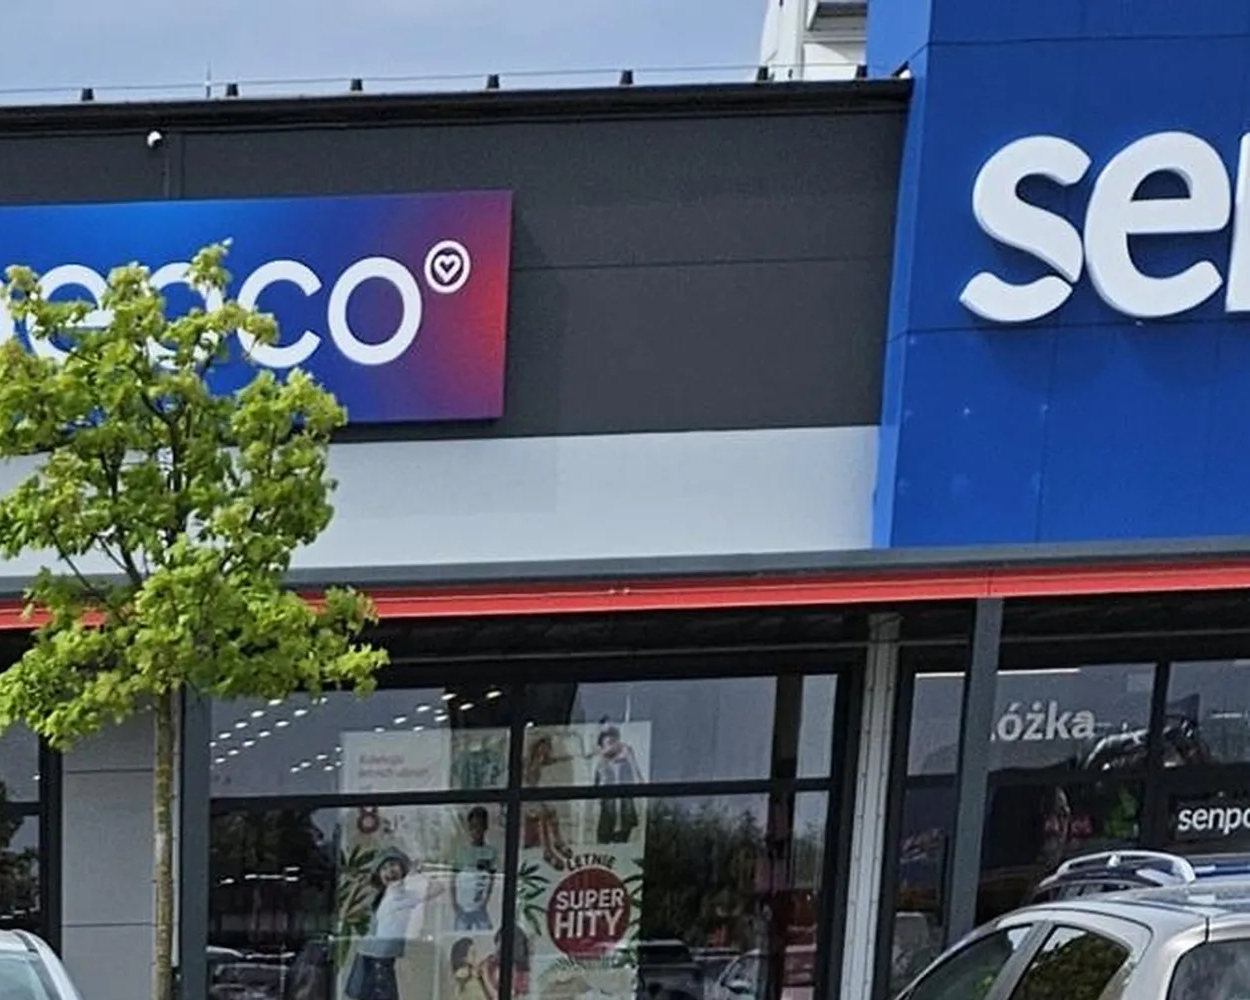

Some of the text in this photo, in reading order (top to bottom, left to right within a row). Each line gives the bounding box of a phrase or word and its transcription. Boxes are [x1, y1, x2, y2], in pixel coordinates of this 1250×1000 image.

[959, 130, 1250, 322] se
[990, 700, 1095, 741] óżka
[555, 888, 625, 911] SUPER
[554, 908, 624, 939] HITY
